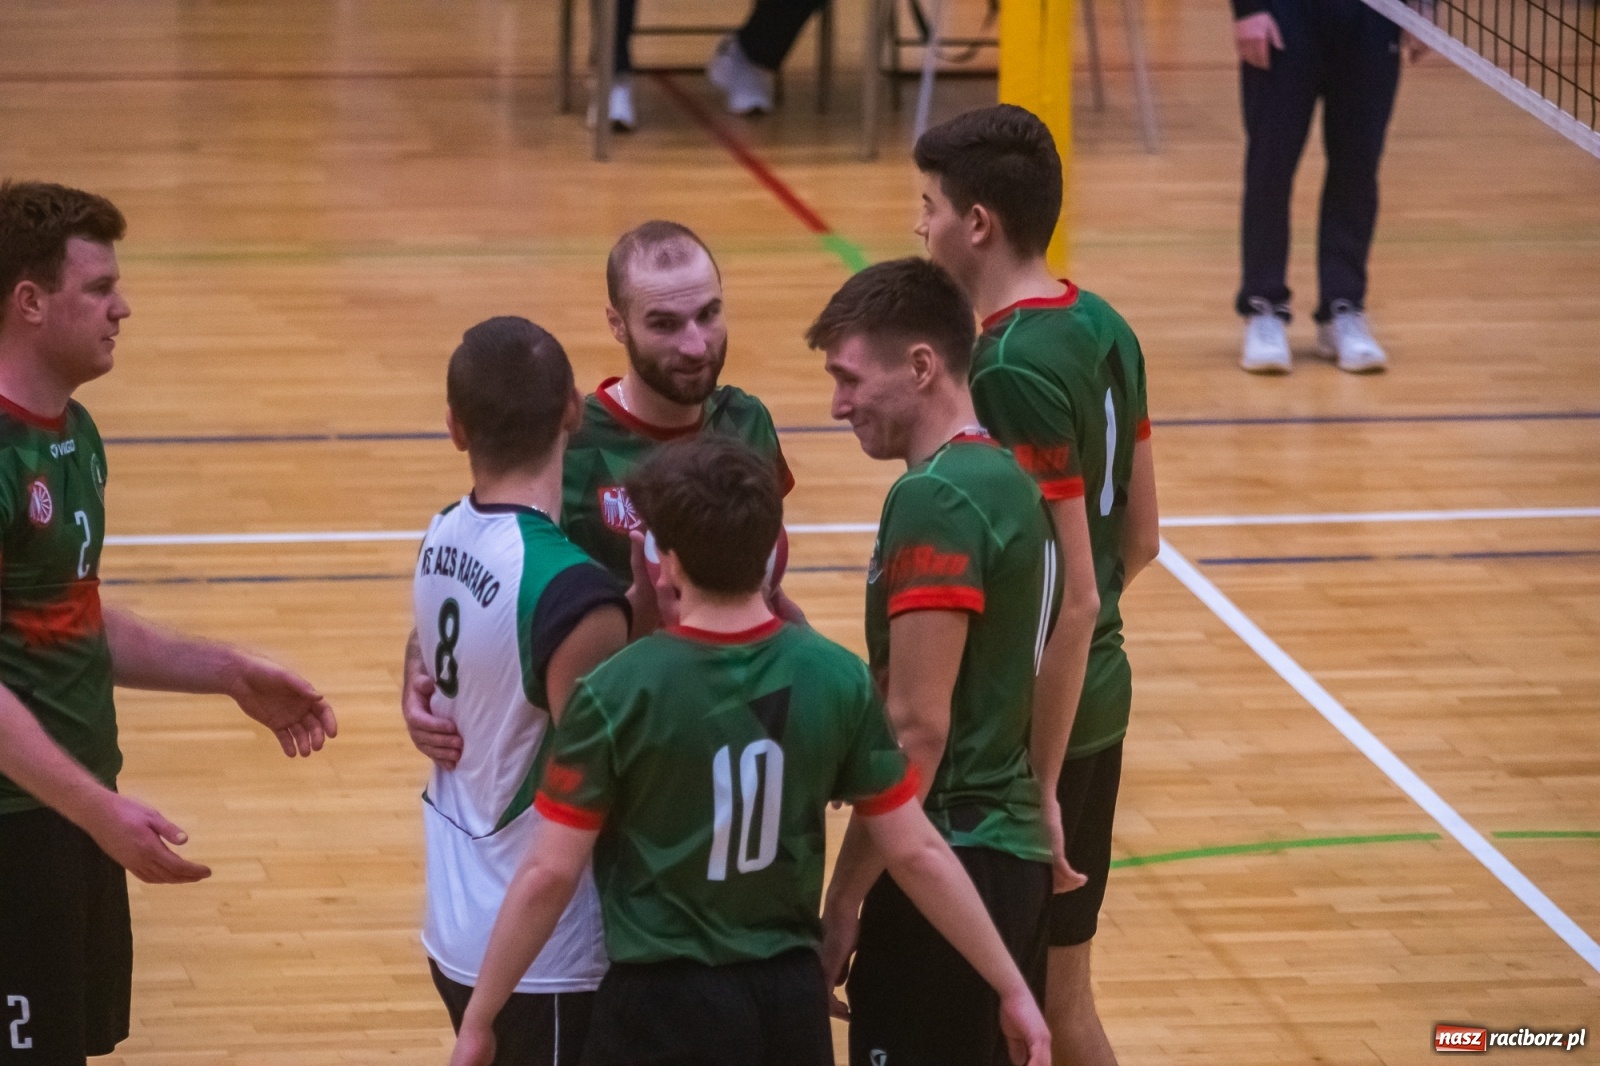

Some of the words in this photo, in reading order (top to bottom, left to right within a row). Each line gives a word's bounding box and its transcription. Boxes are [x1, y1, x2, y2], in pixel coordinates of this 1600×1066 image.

[74, 510, 91, 579] 2
[433, 546, 457, 578] AZS
[457, 551, 501, 608] RAFAKO
[435, 597, 460, 699] 8
[707, 738, 784, 881] 10
[7, 995, 33, 1049] 2
